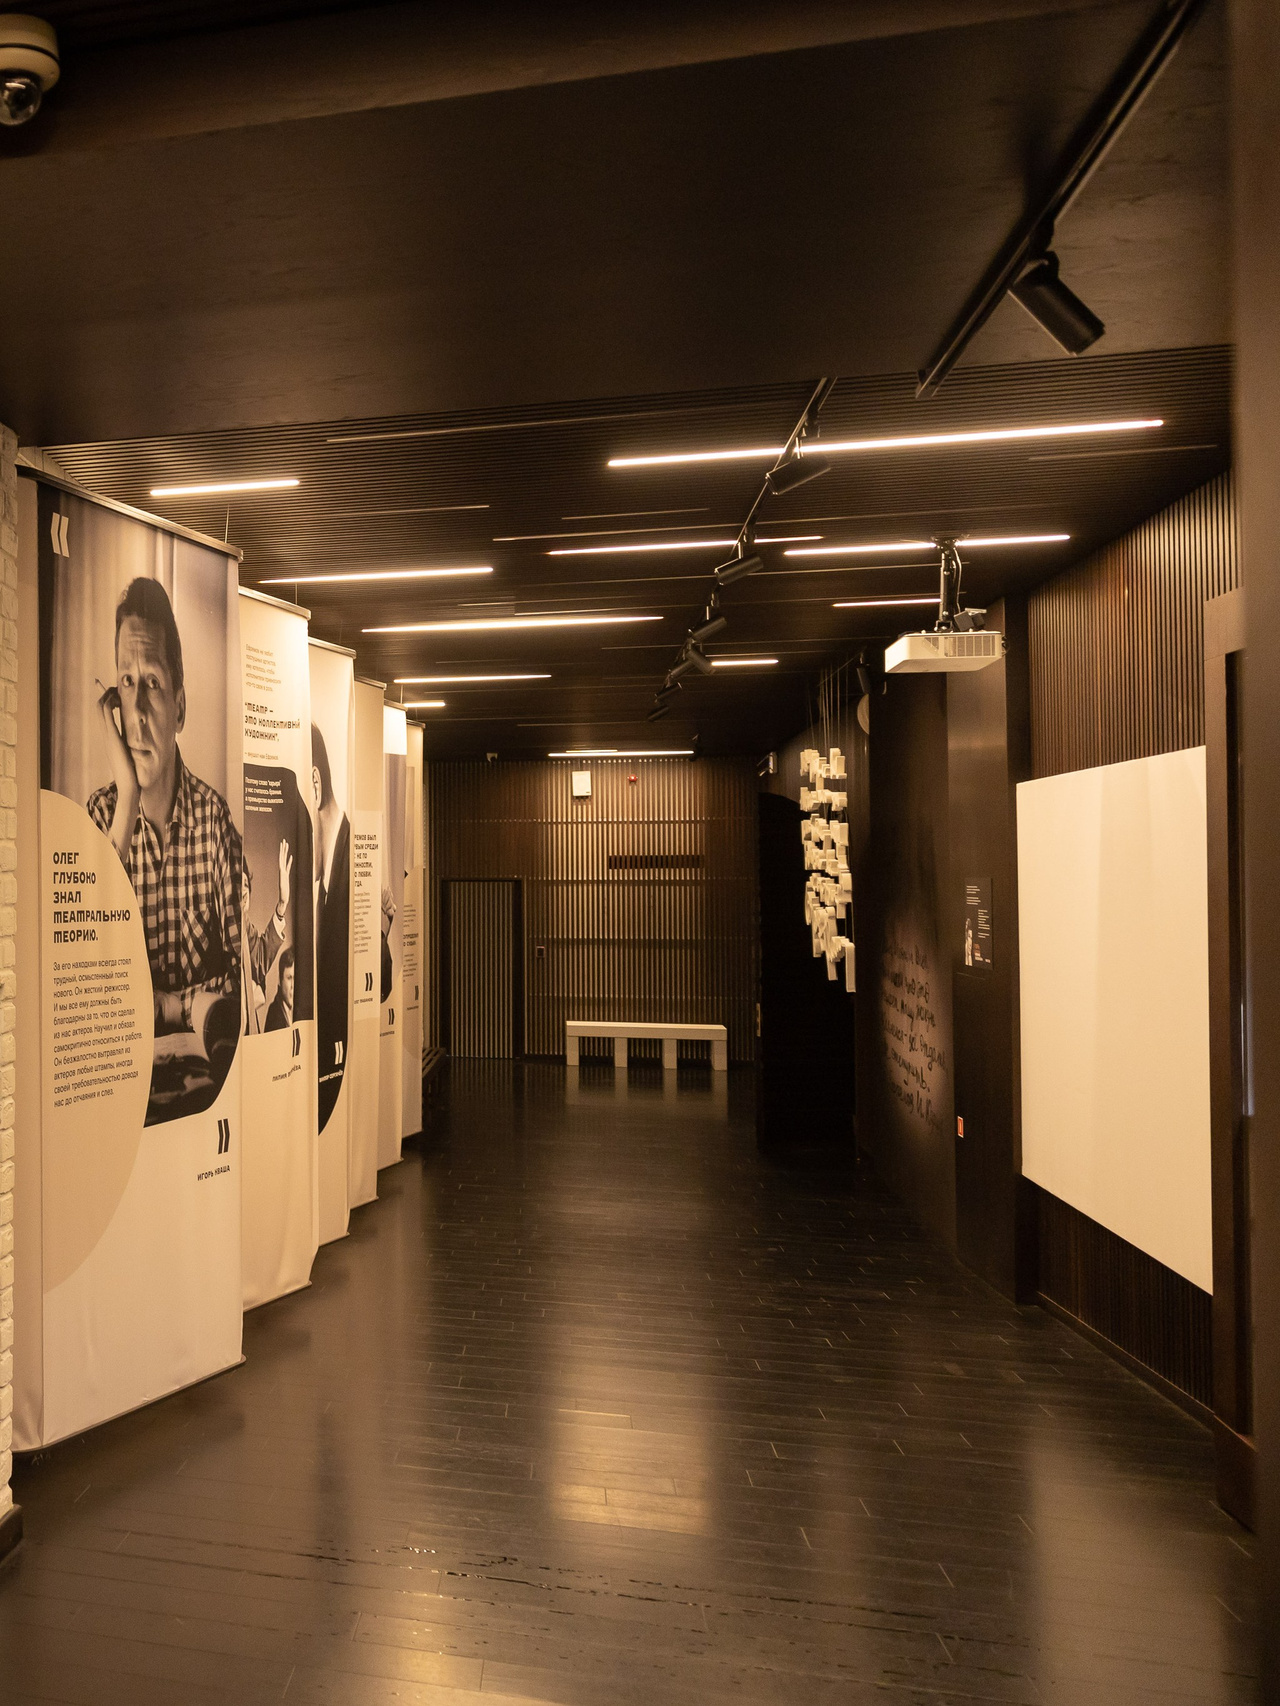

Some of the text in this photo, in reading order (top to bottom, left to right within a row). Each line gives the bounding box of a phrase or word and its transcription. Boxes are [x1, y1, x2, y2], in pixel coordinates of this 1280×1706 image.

[53, 852, 79, 865] ОЛЕГ
[53, 871, 96, 884] ГЛУБОКО
[53, 891, 81, 904] ЗНАЛ
[53, 909, 130, 924] ТЕАТРАЛЬНУЮ
[53, 928, 99, 943] ТЕОРИЮ.
[53, 961, 60, 971] За
[62, 962, 71, 970] его
[98, 959, 117, 967] всегда
[115, 971, 129, 979] поиск
[74, 986, 82, 995] Он
[104, 983, 130, 994] режиссер.
[53, 1003, 58, 1012] И
[68, 1002, 78, 1010] все
[79, 1001, 89, 1010] ему
[90, 998, 109, 1007] должны
[110, 996, 122, 1005] быть
[110, 1010, 117, 1018] он
[118, 1008, 135, 1017] сделал
[94, 1023, 112, 1034] Научил
[53, 1040, 91, 1053] самокритично
[92, 1035, 120, 1046] относиться
[53, 1057, 62, 1067] Он
[63, 1052, 97, 1065] безжалостно
[125, 1046, 131, 1054] из
[53, 1069, 76, 1080] актеров
[76, 1065, 93, 1076] любые
[116, 1058, 133, 1069] иногда
[53, 1083, 71, 1094] своей
[71, 1074, 120, 1091] требовательностью
[53, 1099, 64, 1107] нас
[65, 1097, 72, 1106] до
[73, 1091, 96, 1103] отчаяния
[197, 1170, 214, 1181] ИГОРЬ
